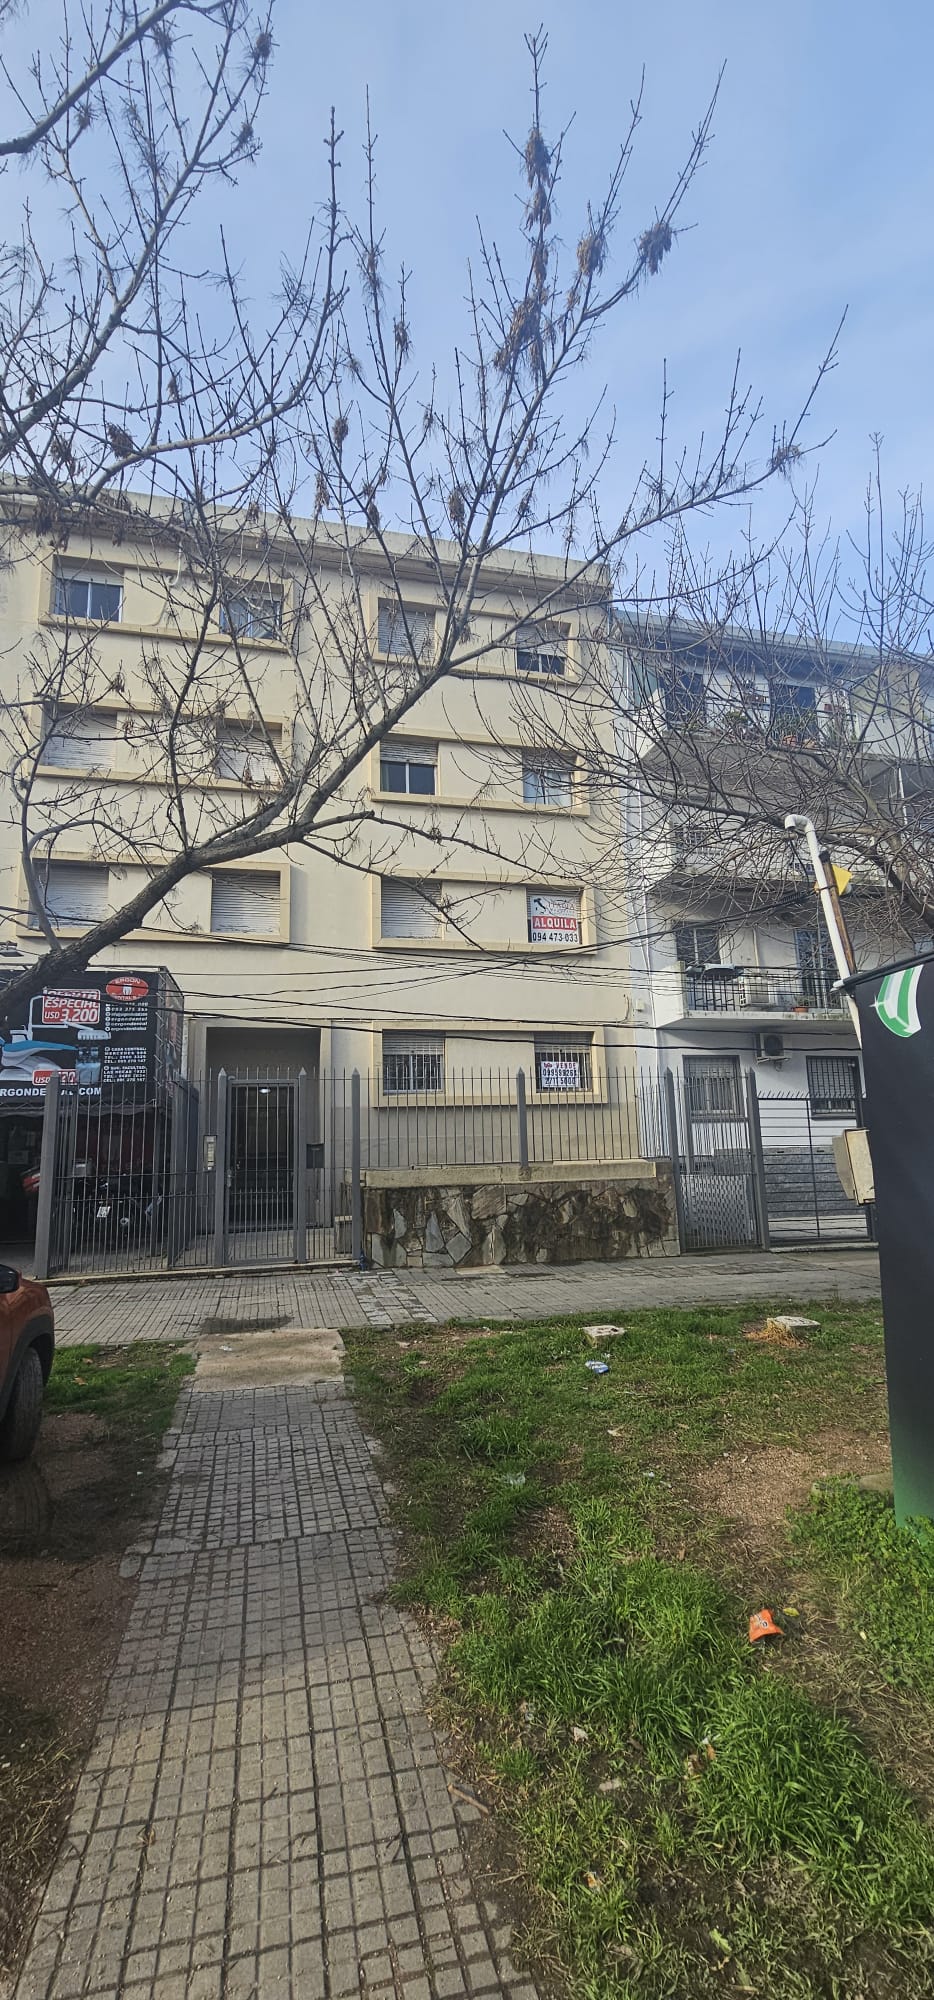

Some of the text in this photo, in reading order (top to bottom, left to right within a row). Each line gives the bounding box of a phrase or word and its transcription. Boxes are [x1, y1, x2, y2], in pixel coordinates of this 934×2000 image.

[534, 918, 576, 929] ALQUILA
[532, 932, 547, 942] 094
[44, 999, 99, 1009] ESPECIAL
[44, 1011, 60, 1019] USD
[60, 1008, 98, 1022] 3.200
